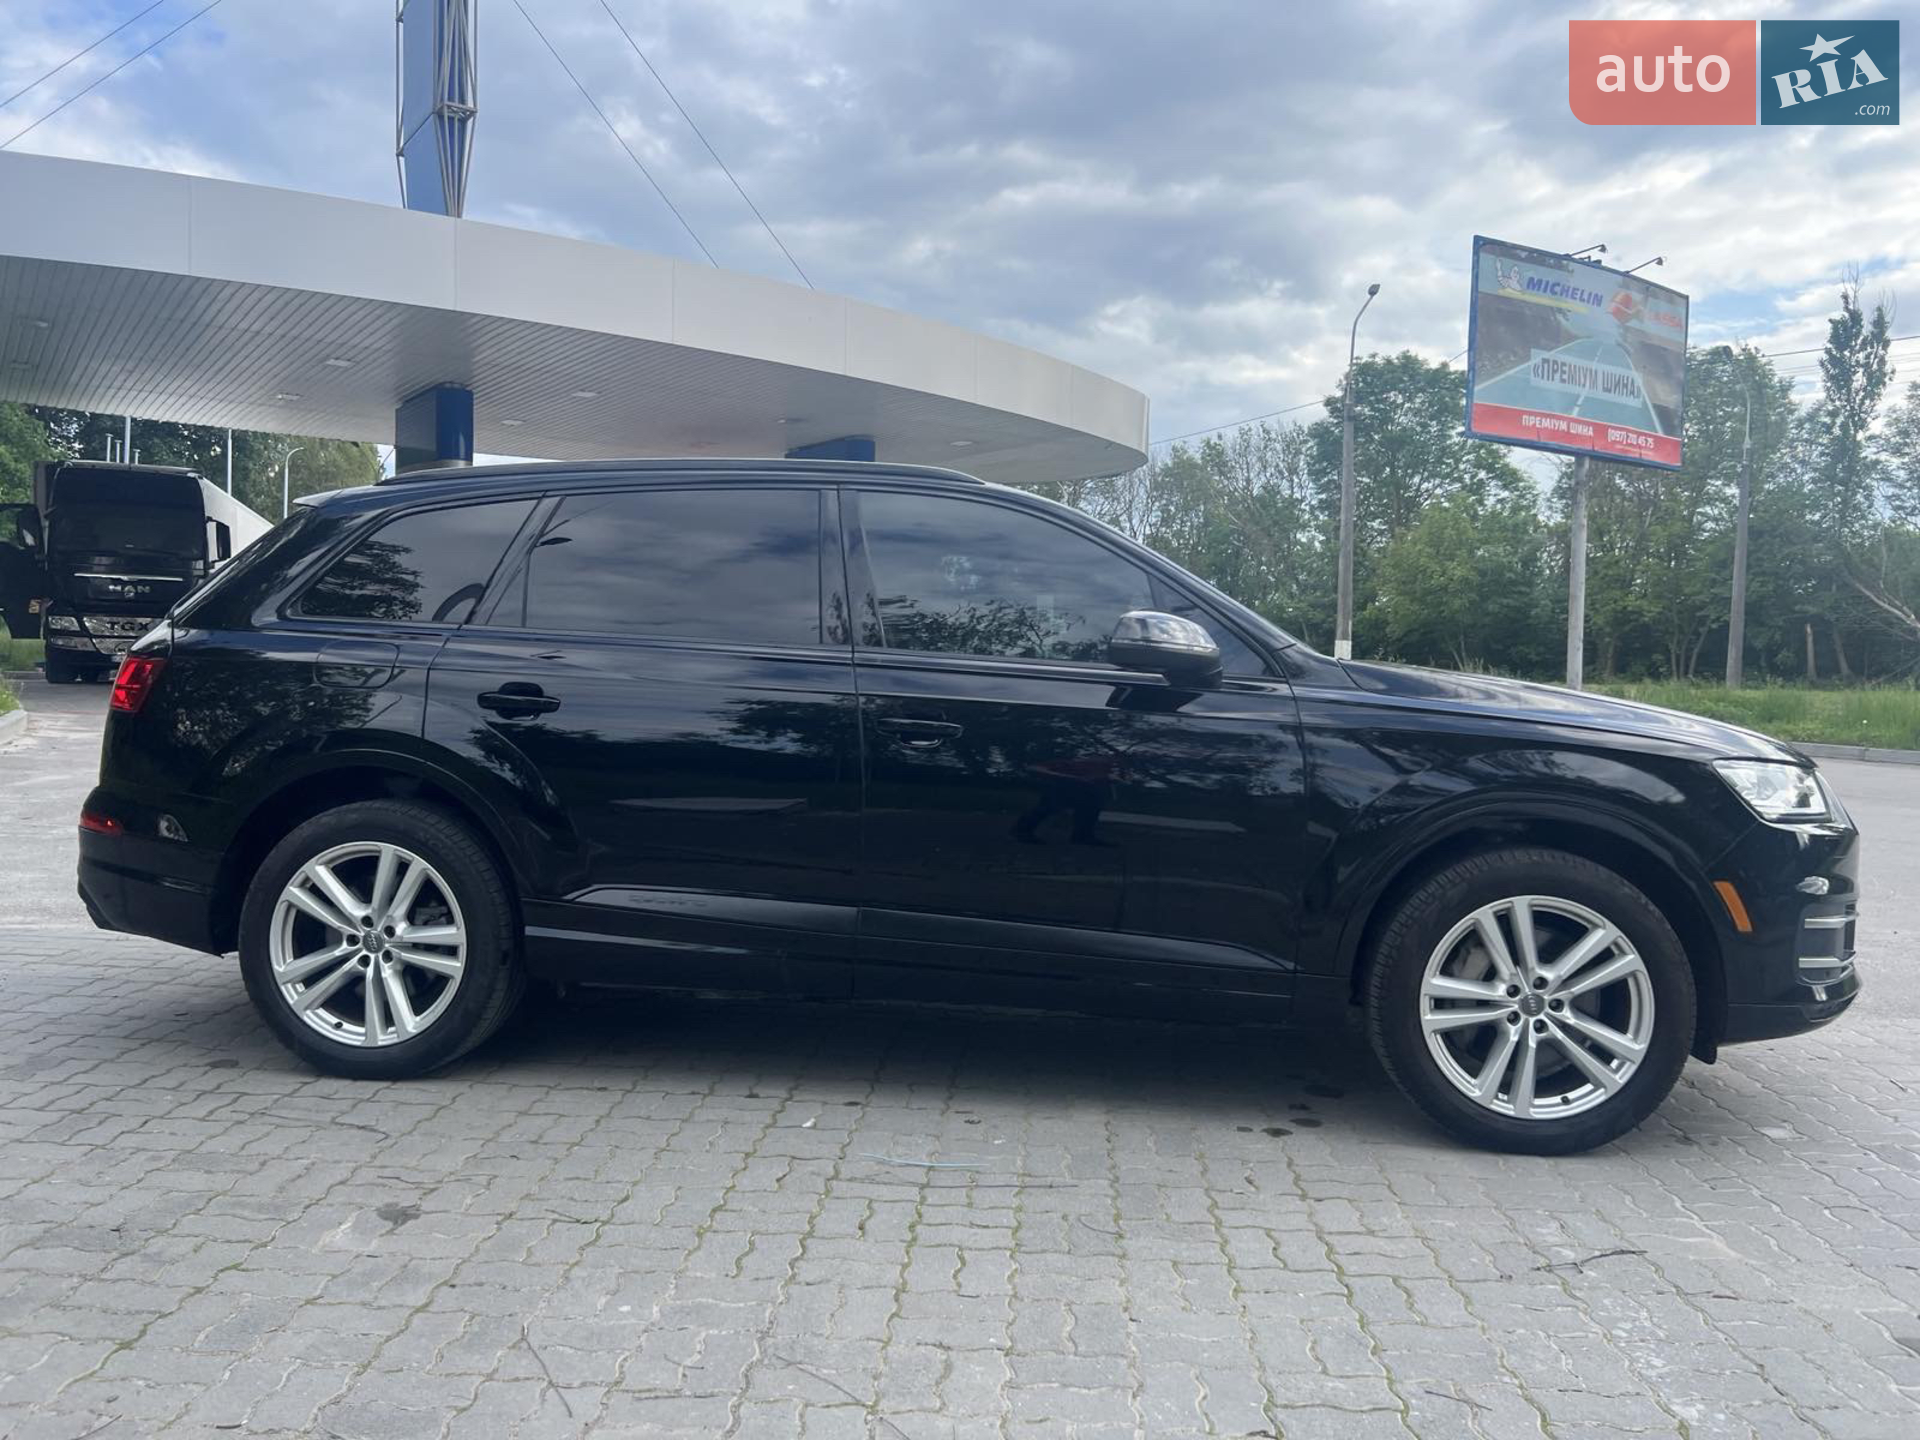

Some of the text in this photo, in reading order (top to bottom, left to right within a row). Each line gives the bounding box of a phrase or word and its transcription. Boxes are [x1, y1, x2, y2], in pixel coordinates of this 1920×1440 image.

[1526, 276, 1604, 308] MICHELIN
[1522, 414, 1594, 437] ПРЕМІУМ ШИНА
[107, 621, 150, 632] TGX
